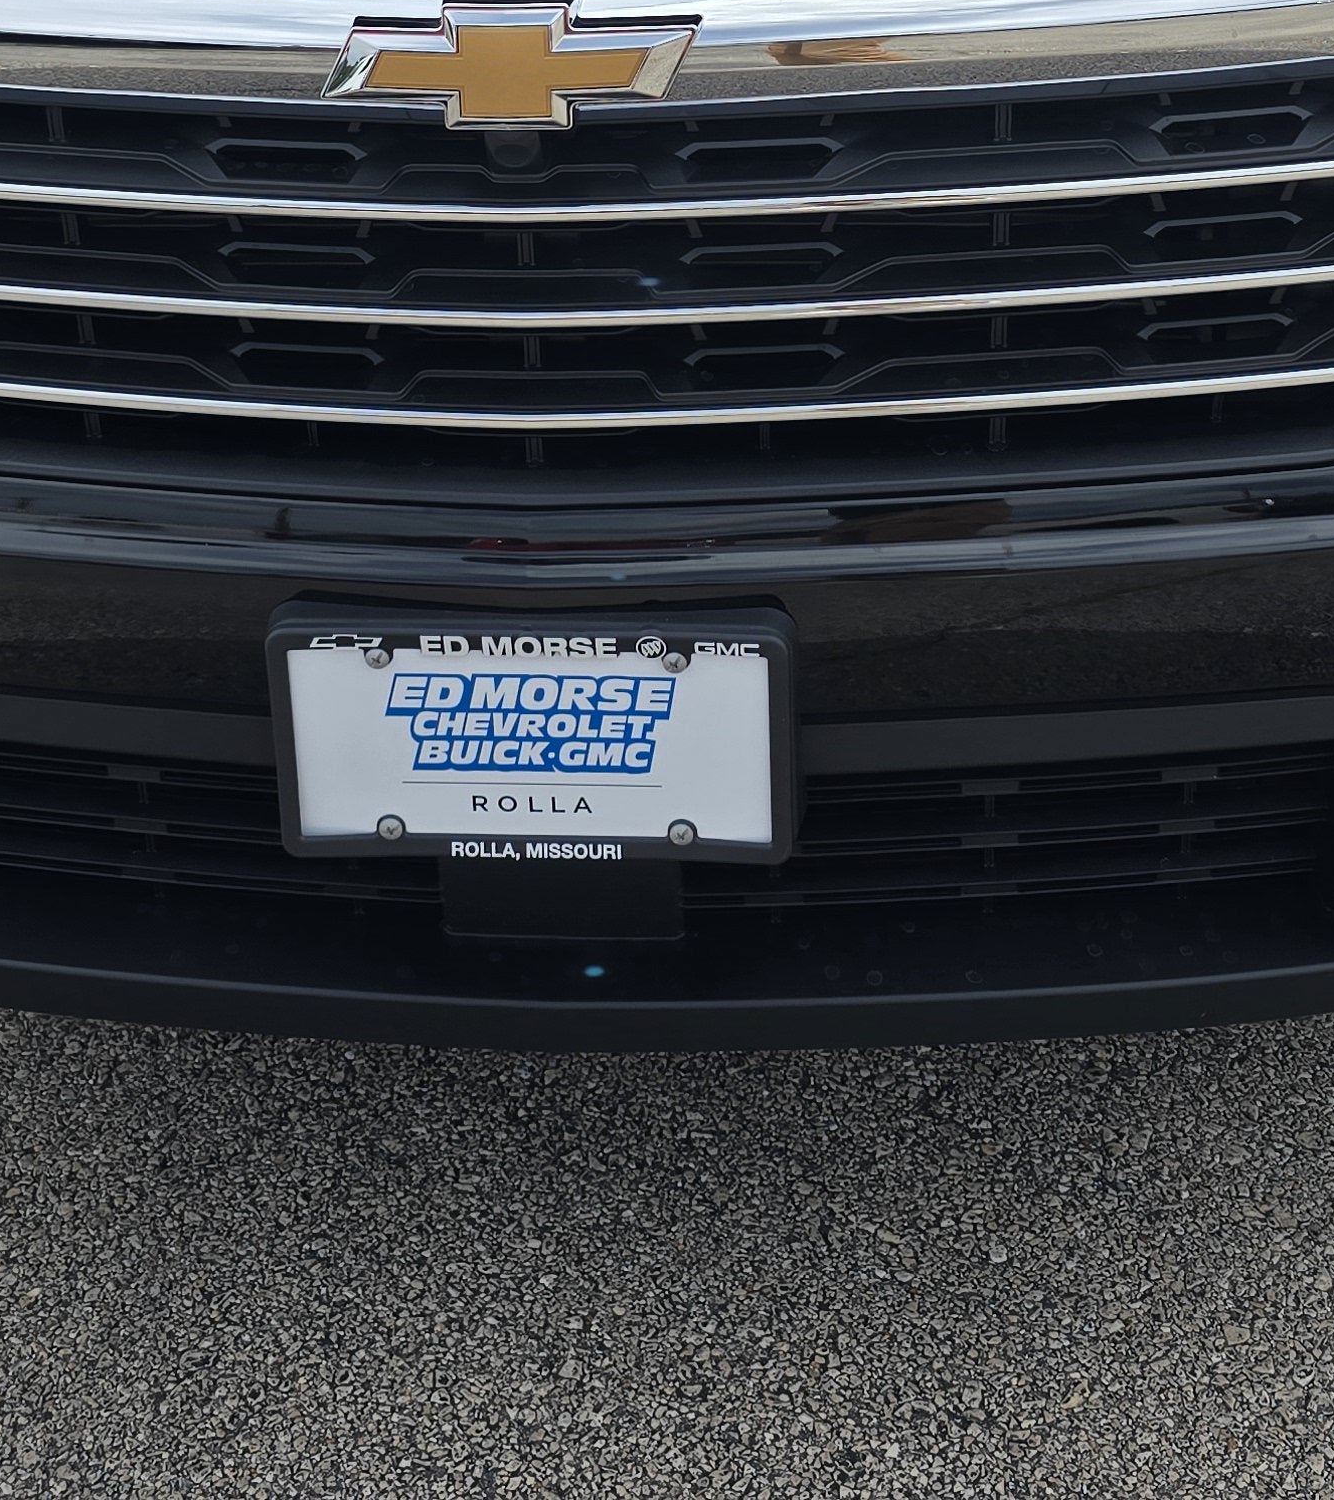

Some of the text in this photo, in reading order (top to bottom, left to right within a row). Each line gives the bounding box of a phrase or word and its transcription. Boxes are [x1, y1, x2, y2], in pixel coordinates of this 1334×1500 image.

[419, 636, 760, 659] ED MORSE GMC
[389, 675, 673, 713] ED MORSE
[413, 710, 653, 740] CHEVROLET
[472, 794, 593, 814] ROLLA
[450, 841, 623, 862] ROLLA, MISSOURI
